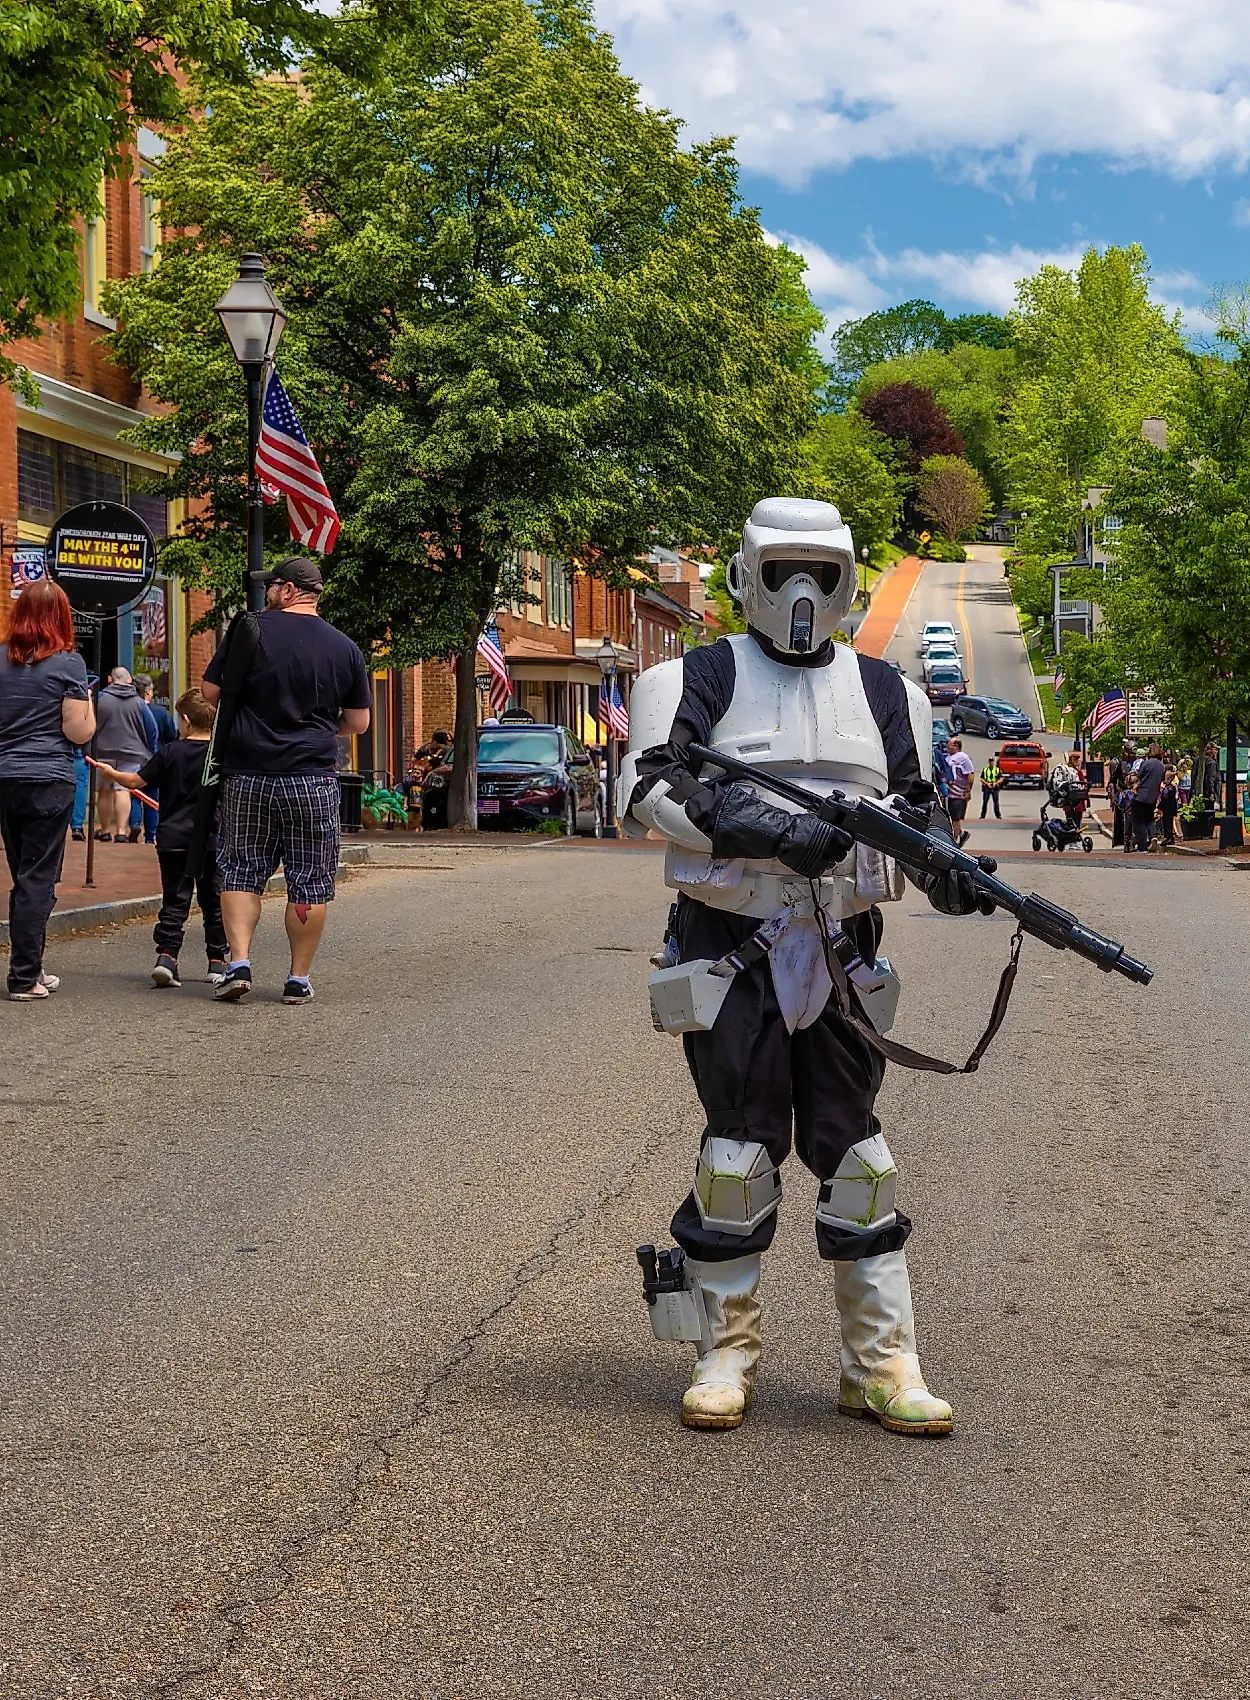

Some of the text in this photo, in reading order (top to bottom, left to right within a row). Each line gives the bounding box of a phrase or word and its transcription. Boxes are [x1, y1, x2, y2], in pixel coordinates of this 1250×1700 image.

[63, 538, 92, 551] MAY
[93, 540, 119, 553] THE
[59, 551, 76, 564] BE
[78, 552, 113, 567] WITH
[114, 556, 143, 569] YOU
